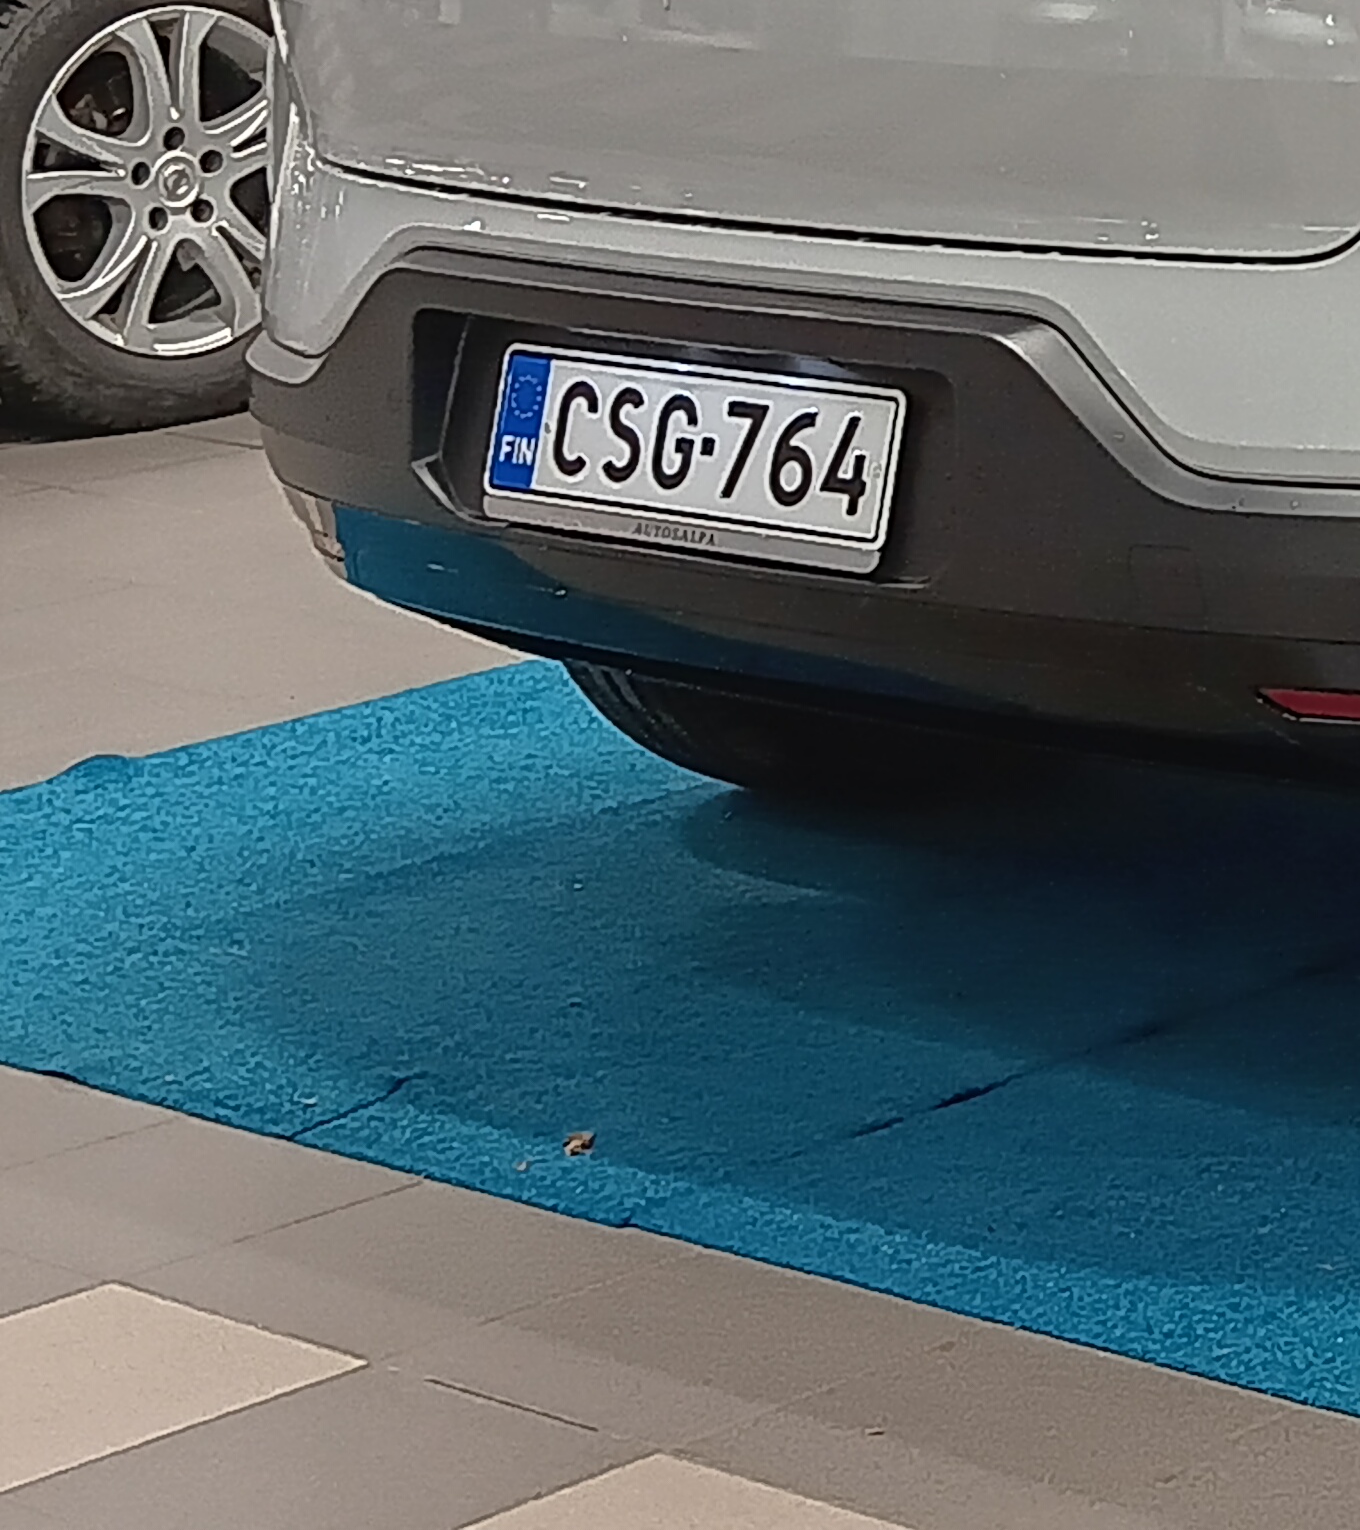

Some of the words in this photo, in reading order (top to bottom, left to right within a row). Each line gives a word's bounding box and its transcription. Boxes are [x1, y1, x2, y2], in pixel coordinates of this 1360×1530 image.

[500, 434, 537, 466] FIN
[553, 380, 868, 516] CSG-764
[632, 522, 716, 547] AUTOSALPA
